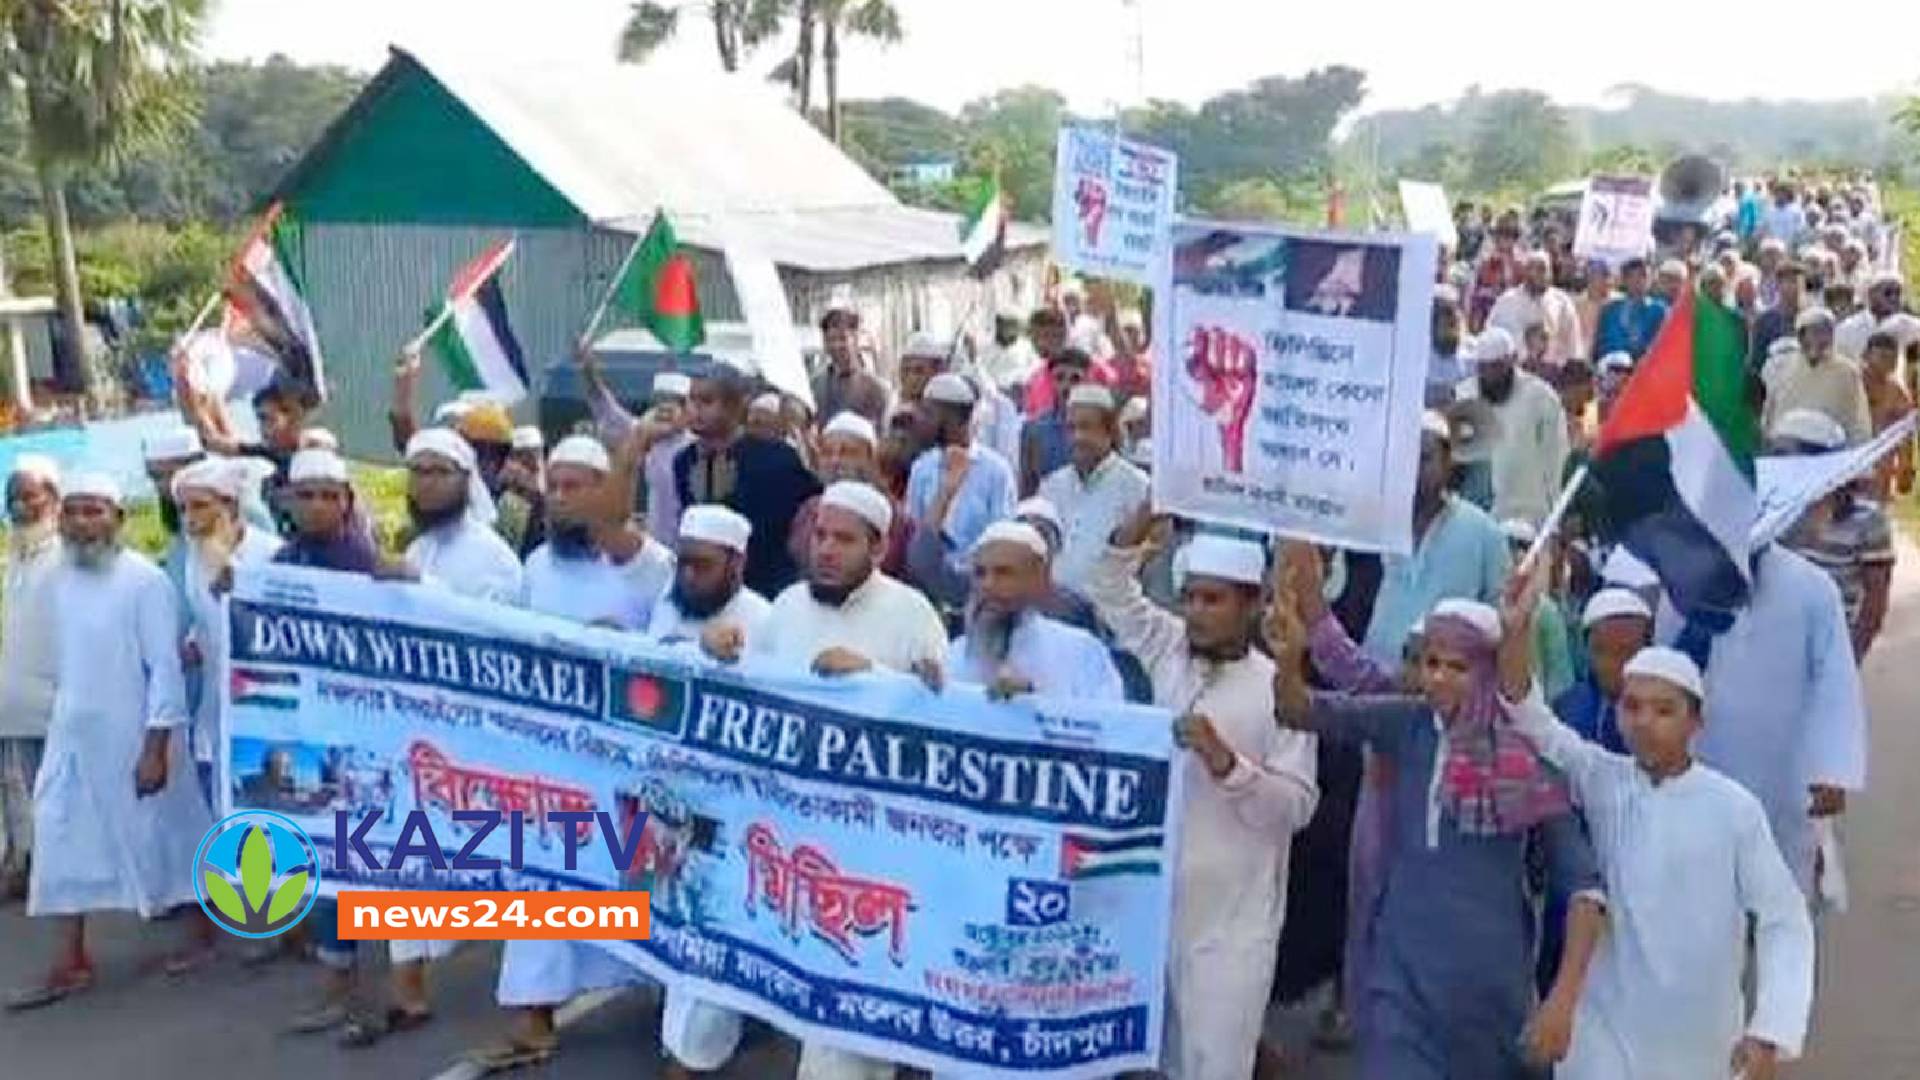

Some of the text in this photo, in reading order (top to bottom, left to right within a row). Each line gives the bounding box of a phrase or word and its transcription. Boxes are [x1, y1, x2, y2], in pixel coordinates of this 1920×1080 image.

[253, 612, 600, 712] DOWN WITH ISRAEL
[696, 692, 1143, 823] FREE PALESTINE
[744, 822, 918, 967] মিছিল
[1013, 881, 1066, 922] ২০
